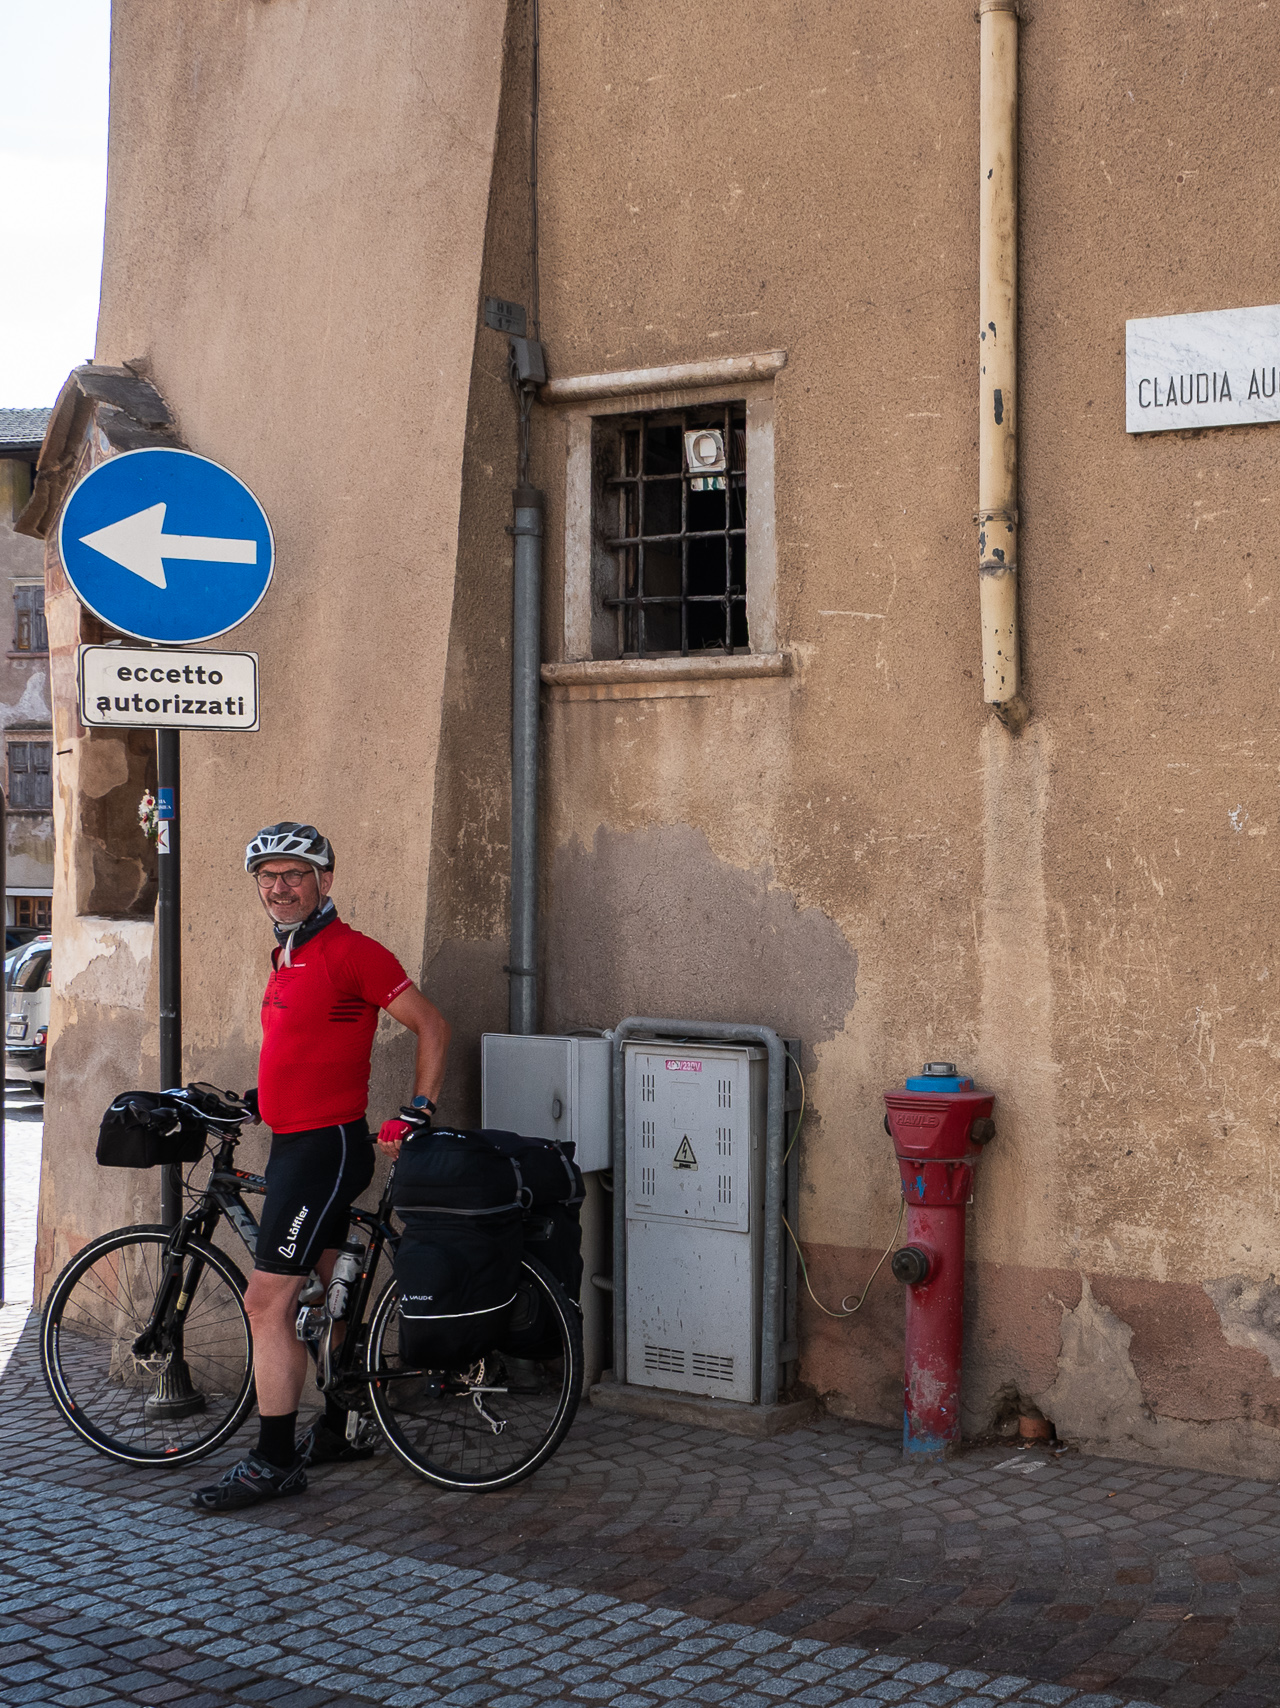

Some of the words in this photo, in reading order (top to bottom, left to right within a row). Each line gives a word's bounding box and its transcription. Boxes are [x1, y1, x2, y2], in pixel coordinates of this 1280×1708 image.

[1138, 370, 1232, 409] CLAUDIA
[117, 664, 223, 685] eccetto
[96, 693, 244, 716] autorizzati
[897, 1113, 936, 1126] HAWLE
[286, 1205, 309, 1241] Löffler
